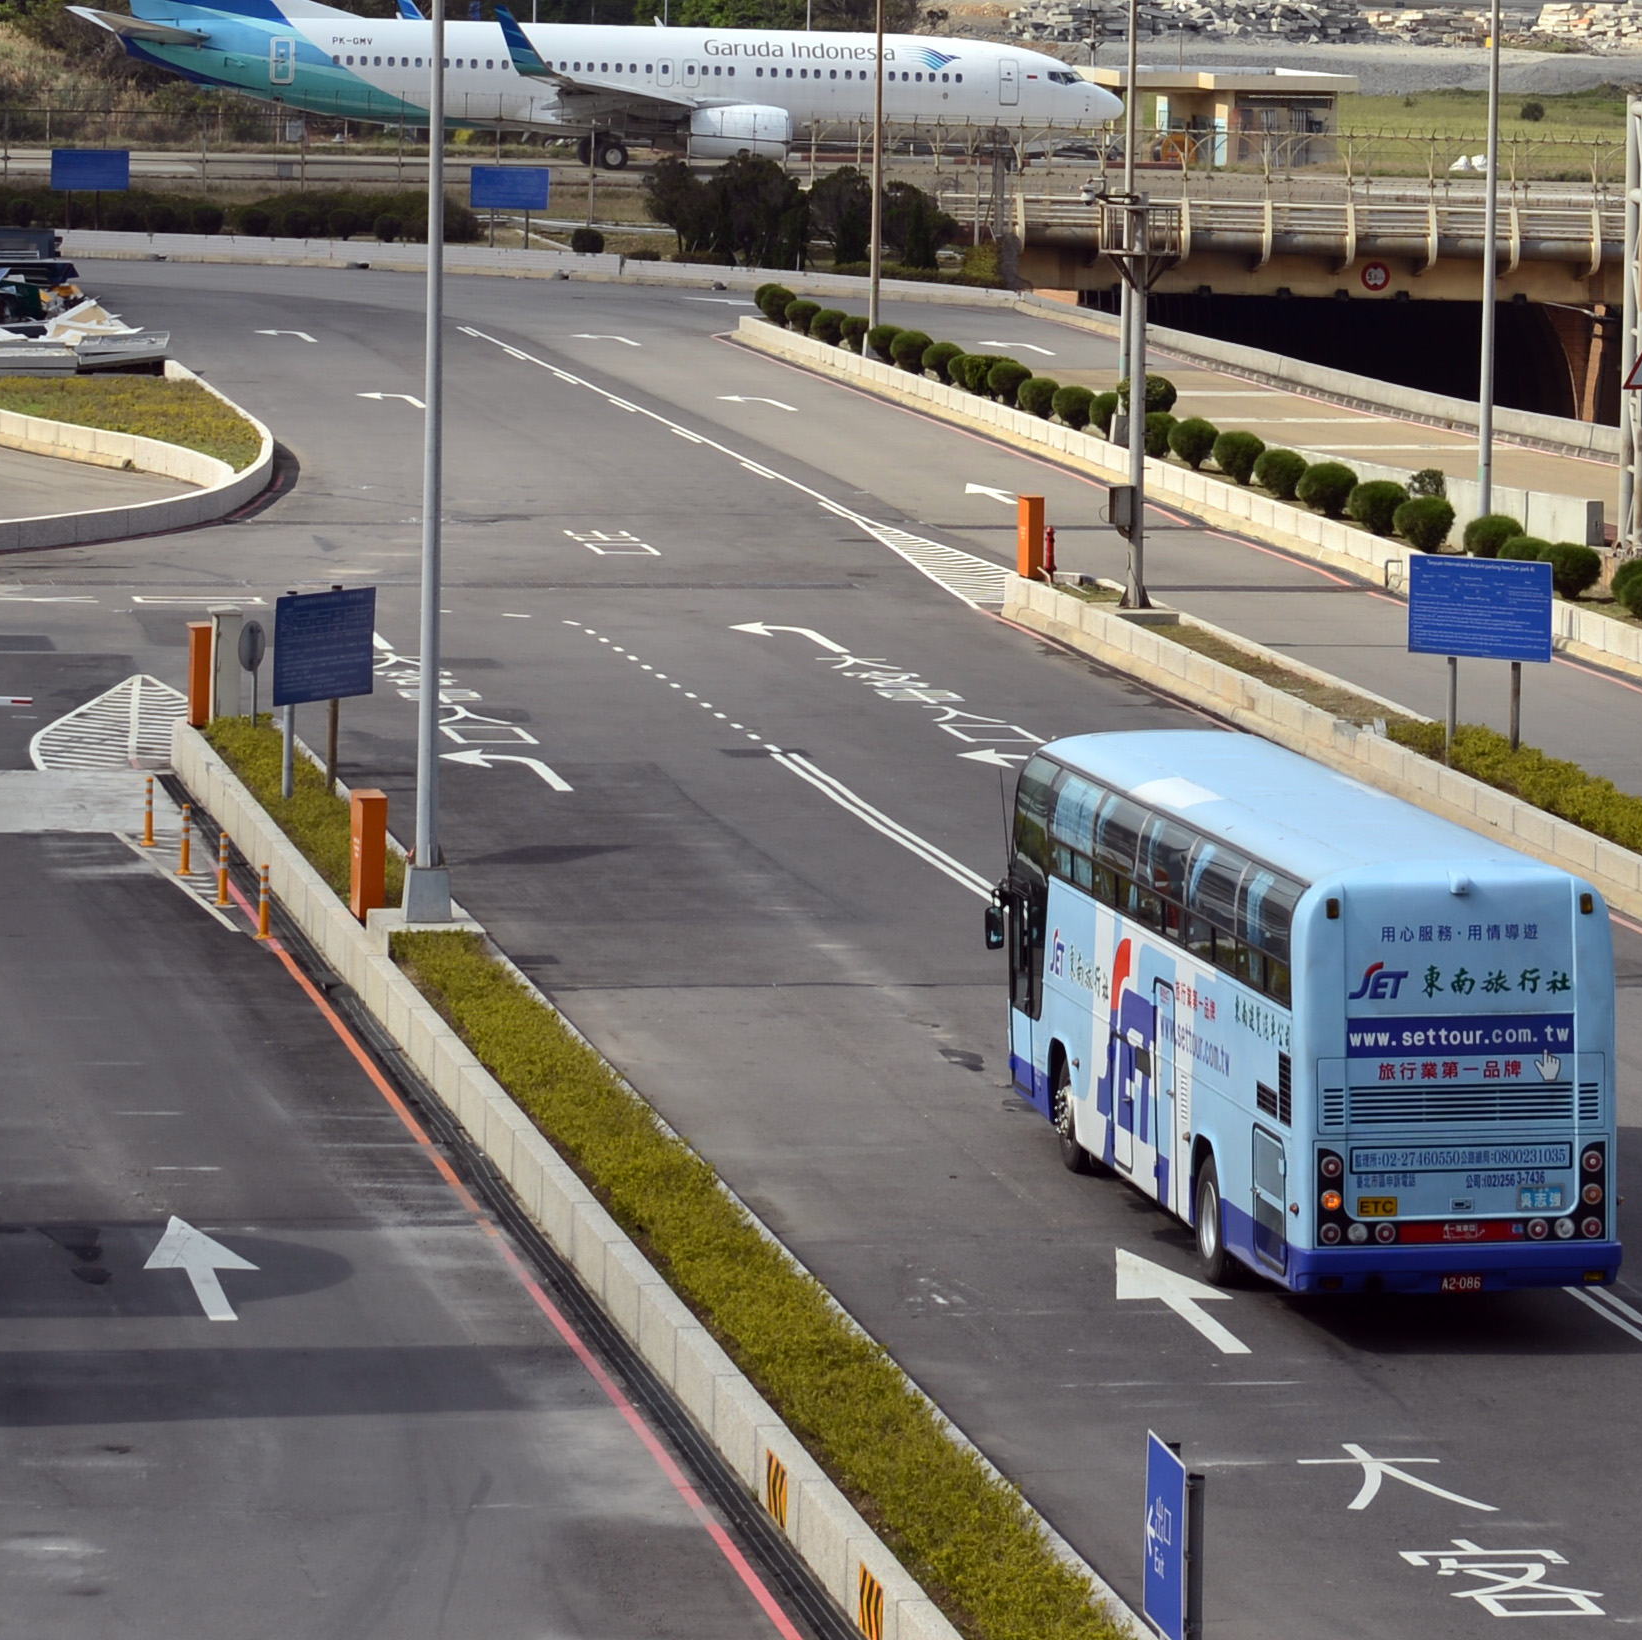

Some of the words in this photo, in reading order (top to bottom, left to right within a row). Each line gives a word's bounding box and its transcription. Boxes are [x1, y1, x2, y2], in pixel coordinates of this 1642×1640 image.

[332, 36, 373, 46] PK-GMV
[703, 39, 784, 58] Garuda
[791, 42, 896, 61] Indonesa
[1421, 964, 1572, 999] 東南旅行社
[1349, 1024, 1570, 1047] www.settour.com.tw
[1378, 1060, 1522, 1081] 旅行業第一品牌
[1360, 1201, 1394, 1214] ETC
[1441, 1276, 1481, 1291] A2-086
[1155, 1496, 1172, 1547] 出口
